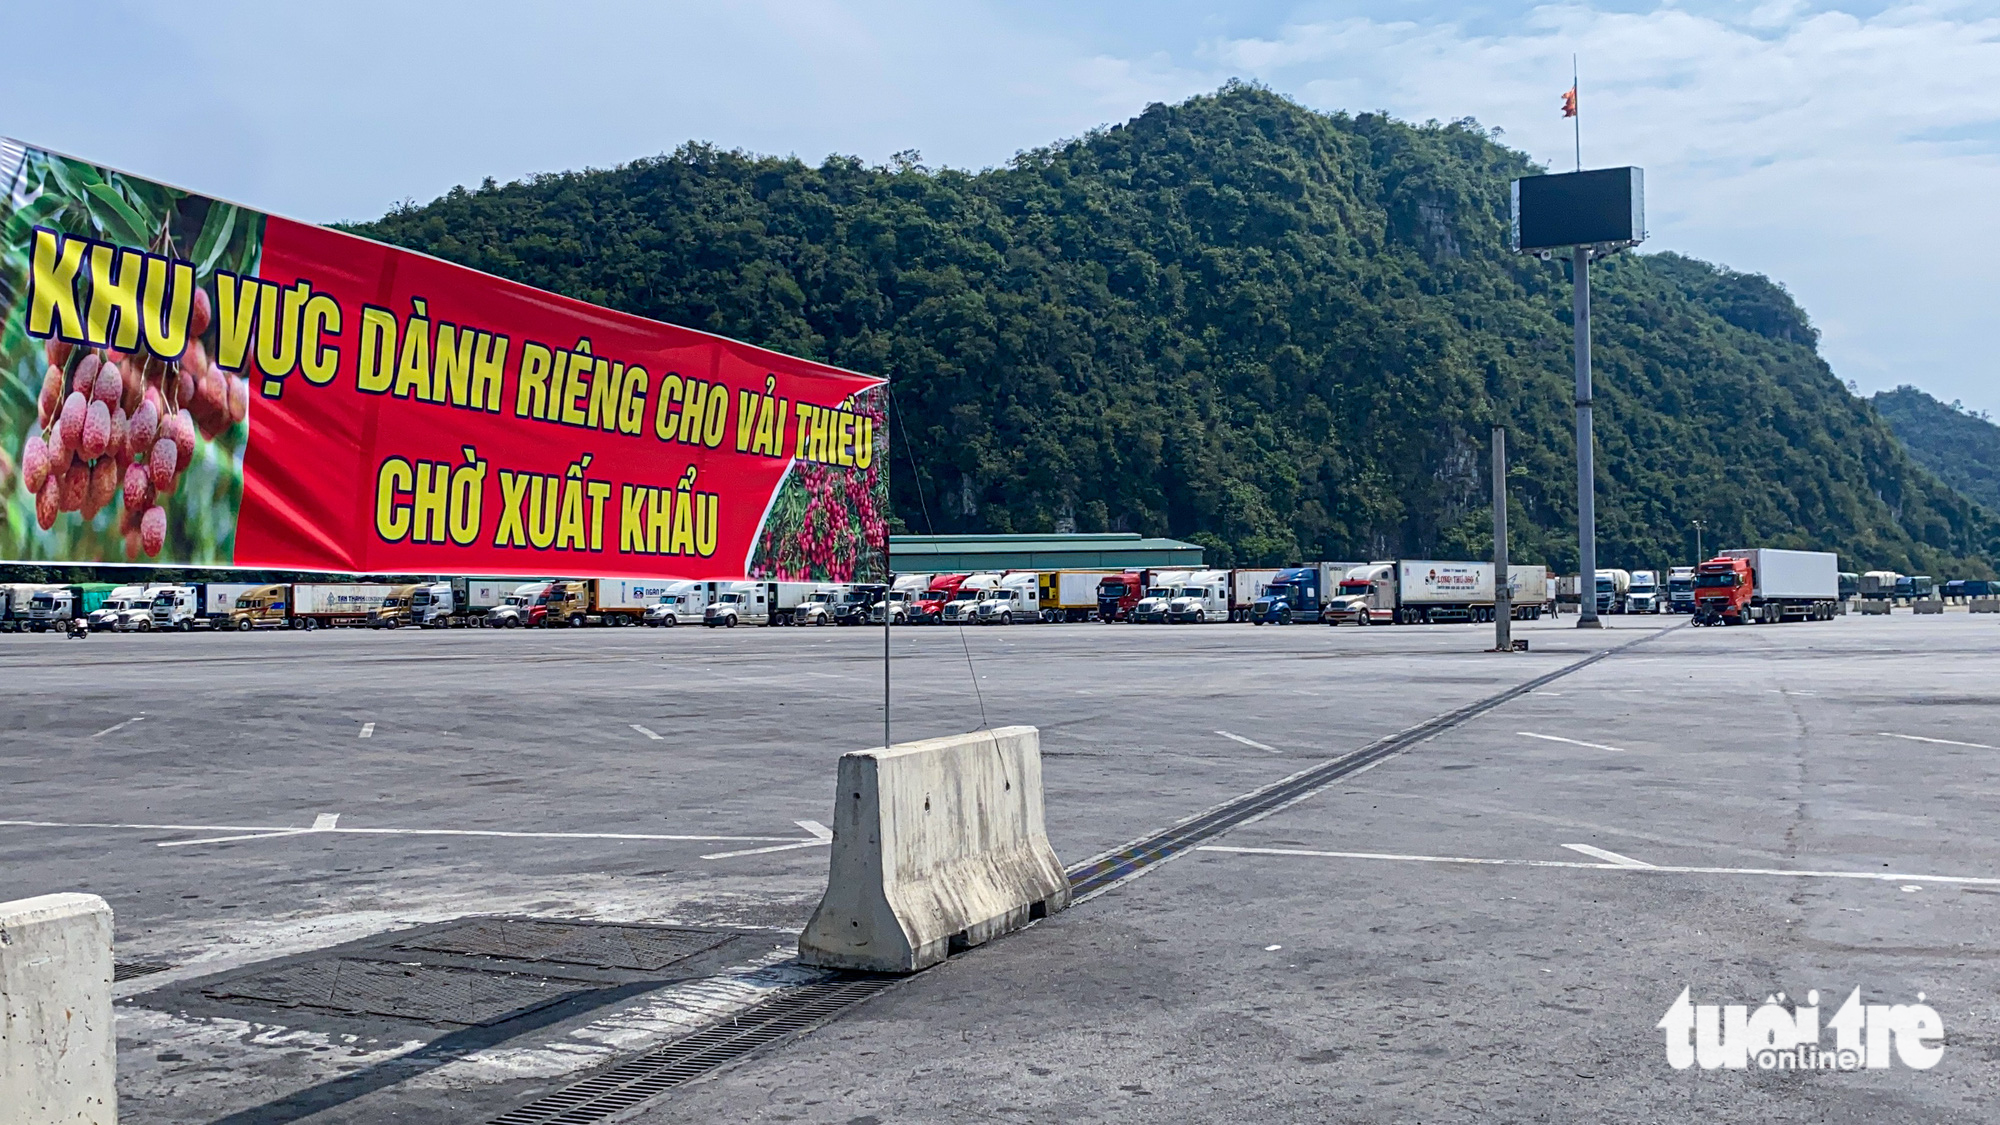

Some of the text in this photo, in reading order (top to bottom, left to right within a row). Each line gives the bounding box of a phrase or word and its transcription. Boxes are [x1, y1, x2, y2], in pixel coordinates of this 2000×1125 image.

[28, 227, 873, 470] KHU VỰC DÀNH RIÊNG CHO VẢI THIỀU
[375, 445, 722, 559] CHỜ XUẤT KHẨU
